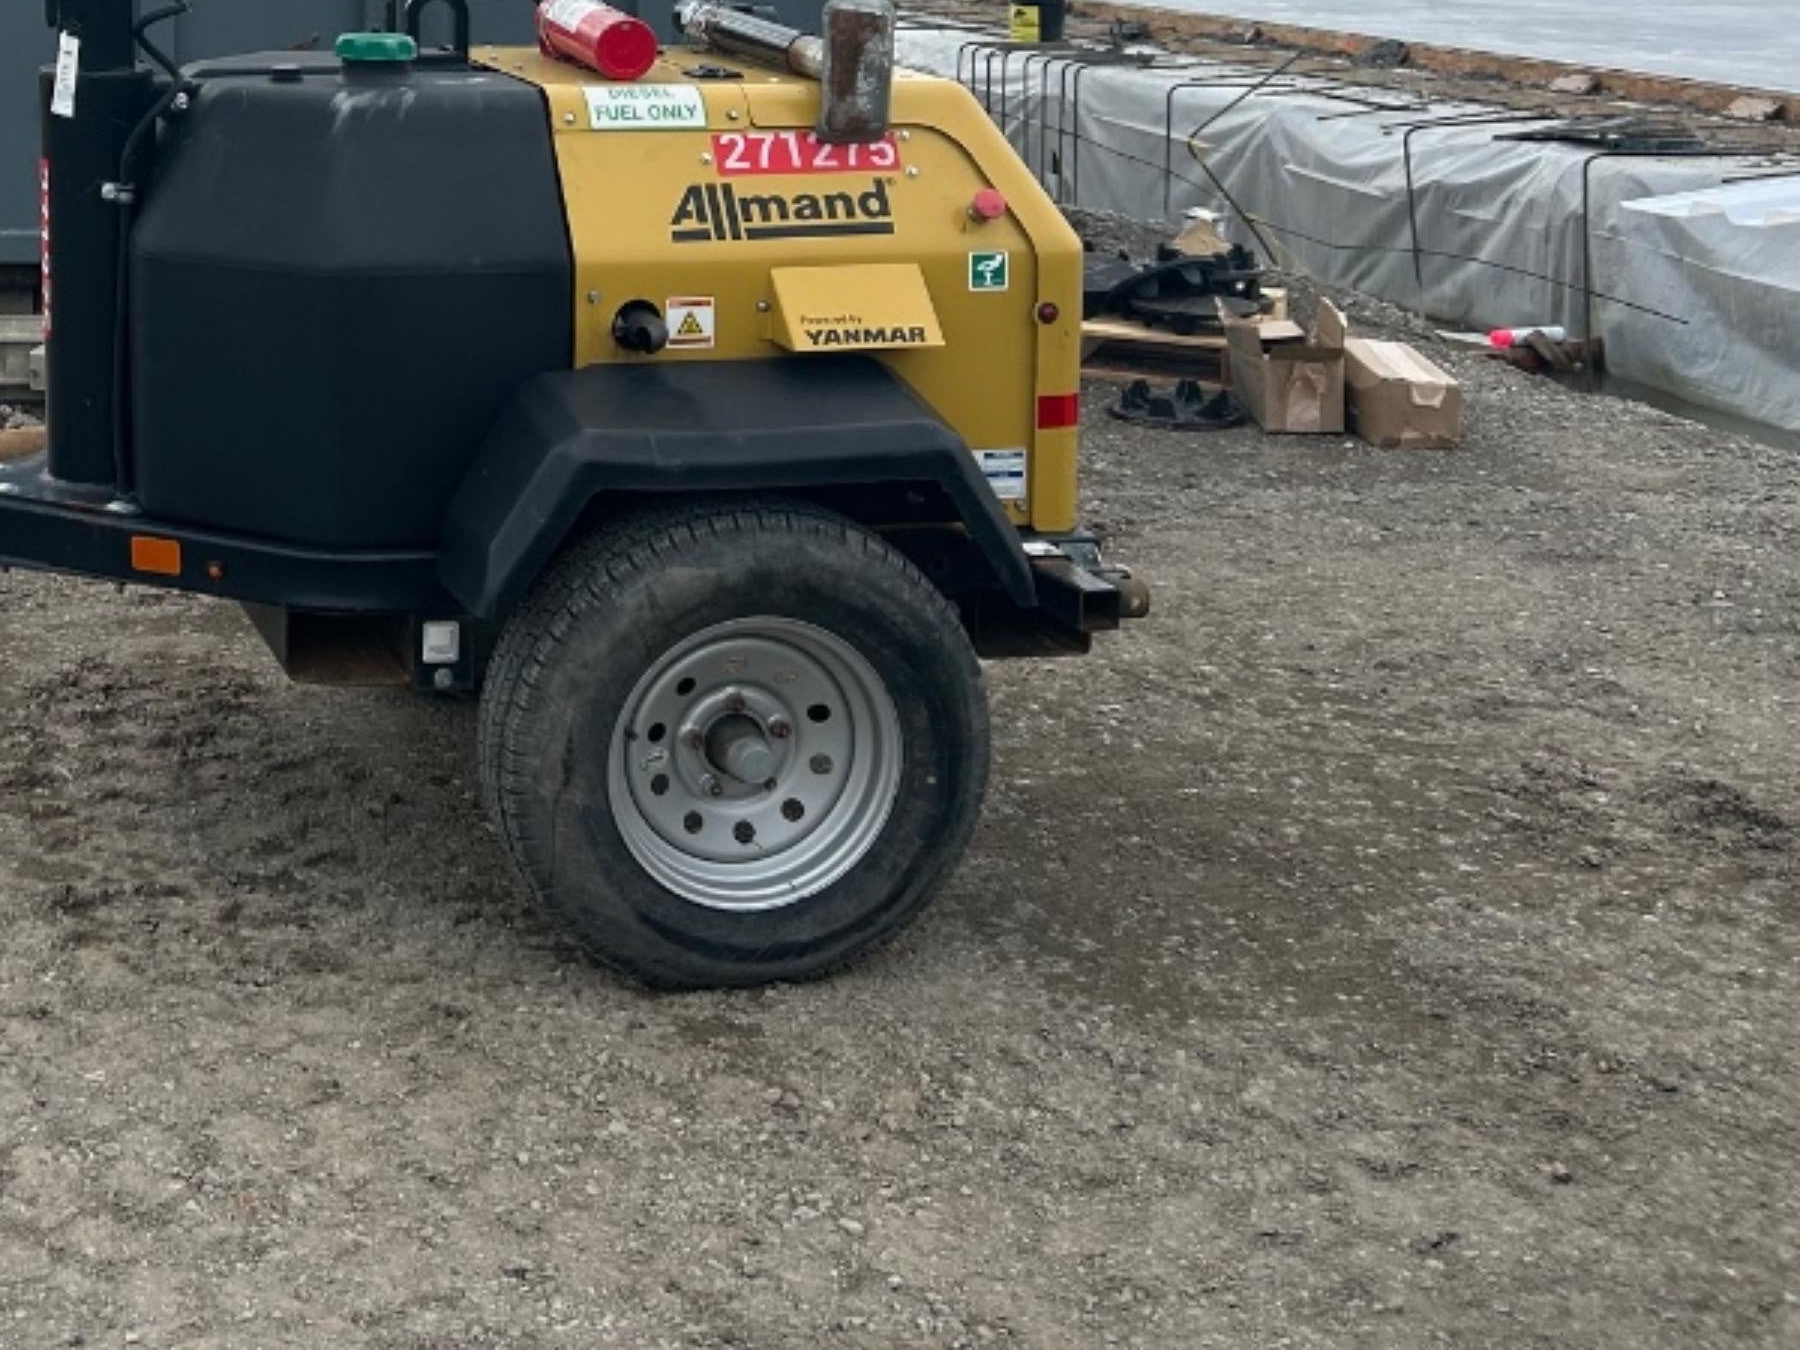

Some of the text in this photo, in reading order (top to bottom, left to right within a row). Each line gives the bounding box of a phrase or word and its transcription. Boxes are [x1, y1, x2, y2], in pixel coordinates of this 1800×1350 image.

[594, 103, 697, 121] FUEL ONLY
[671, 177, 892, 241] Allmand
[804, 326, 927, 346] YANMAR
